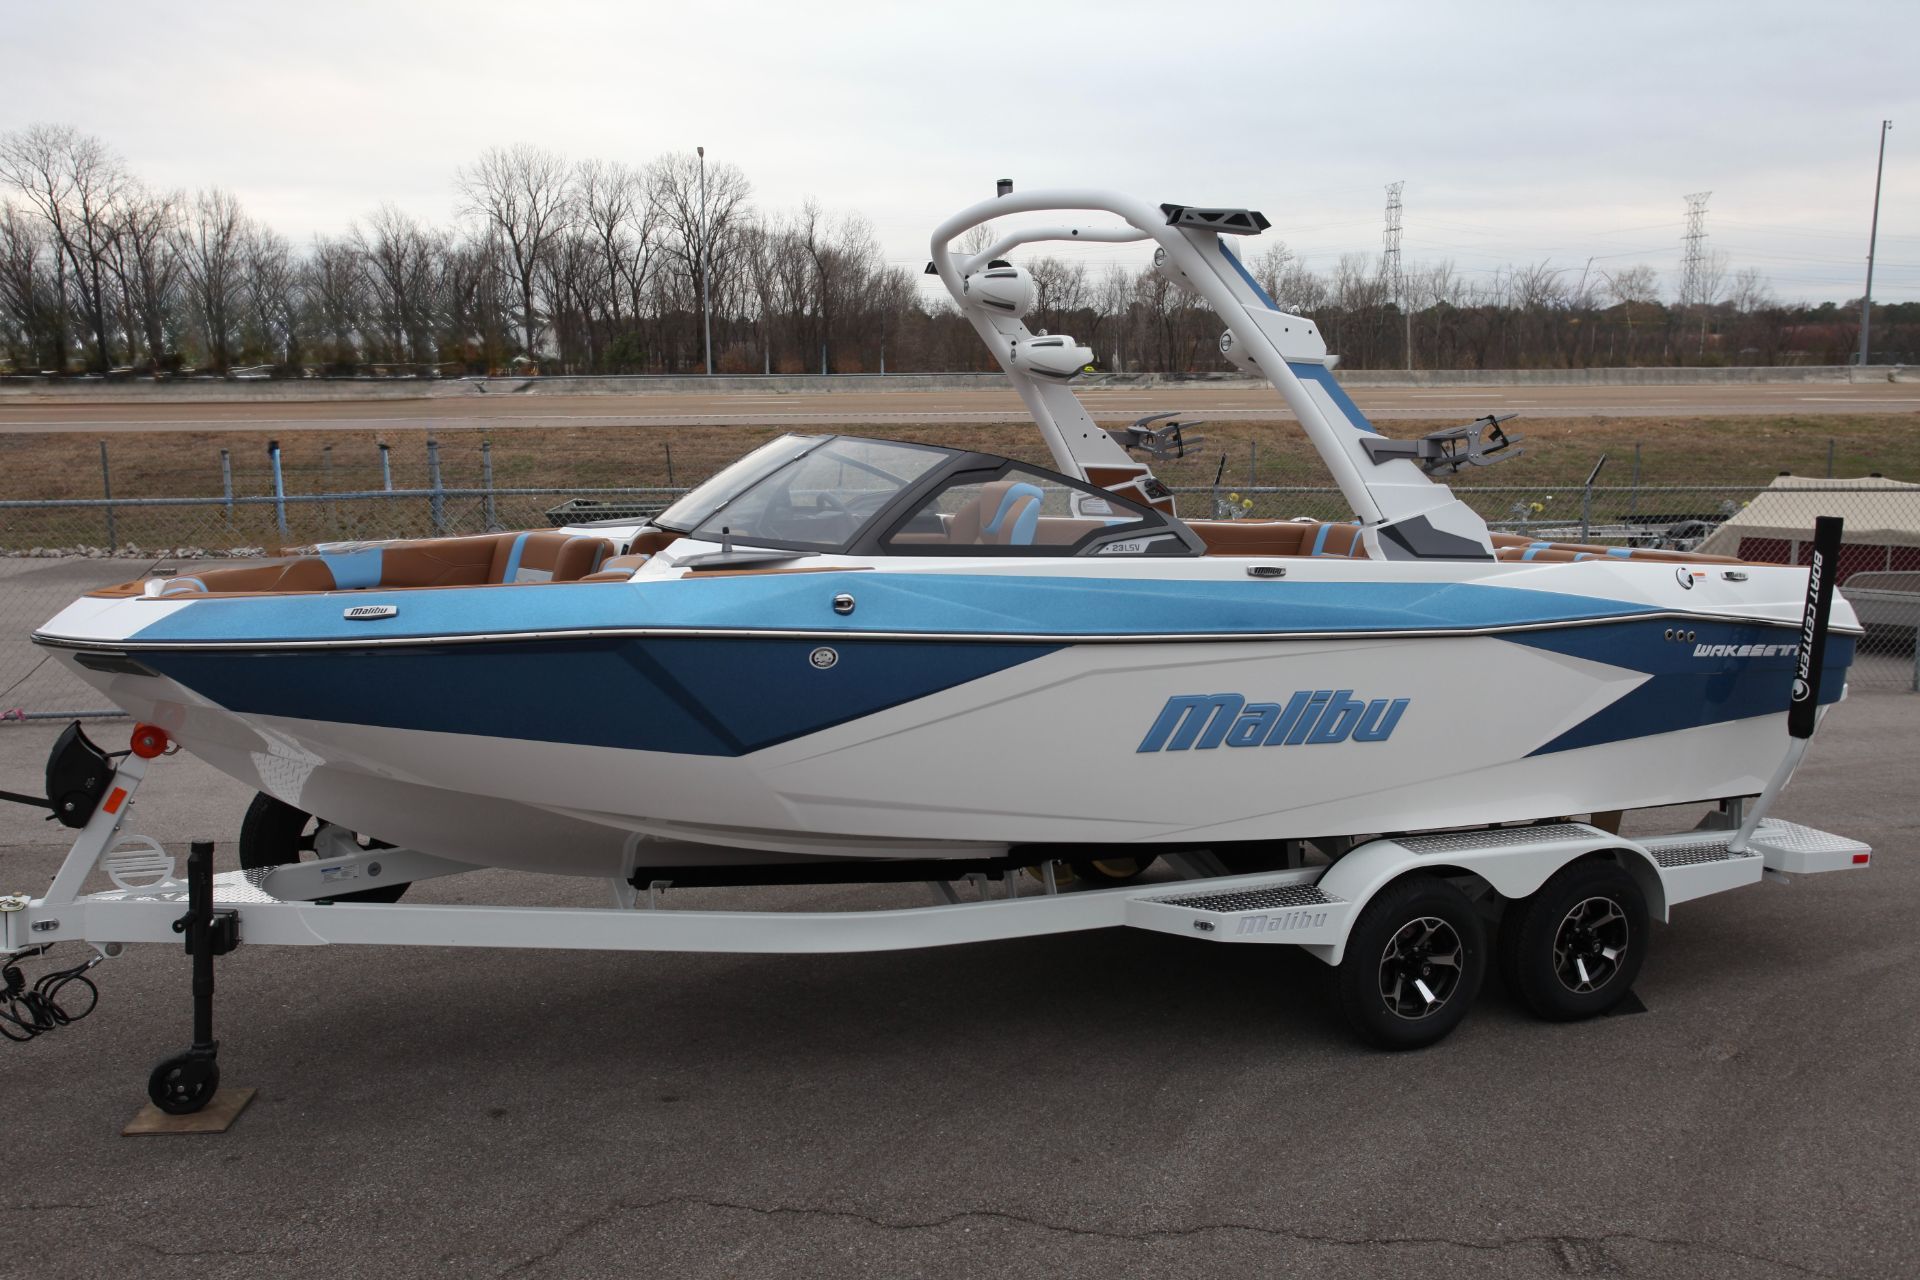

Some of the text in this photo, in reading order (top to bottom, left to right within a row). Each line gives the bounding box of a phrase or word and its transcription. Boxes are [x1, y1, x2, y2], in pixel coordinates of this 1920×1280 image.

[1112, 544, 1140, 552] 23LSV
[350, 607, 388, 616] Malibu
[1799, 550, 1823, 679] BOAT CENTER
[1135, 689, 1411, 754] Malibu
[1235, 911, 1328, 935] Malibu
